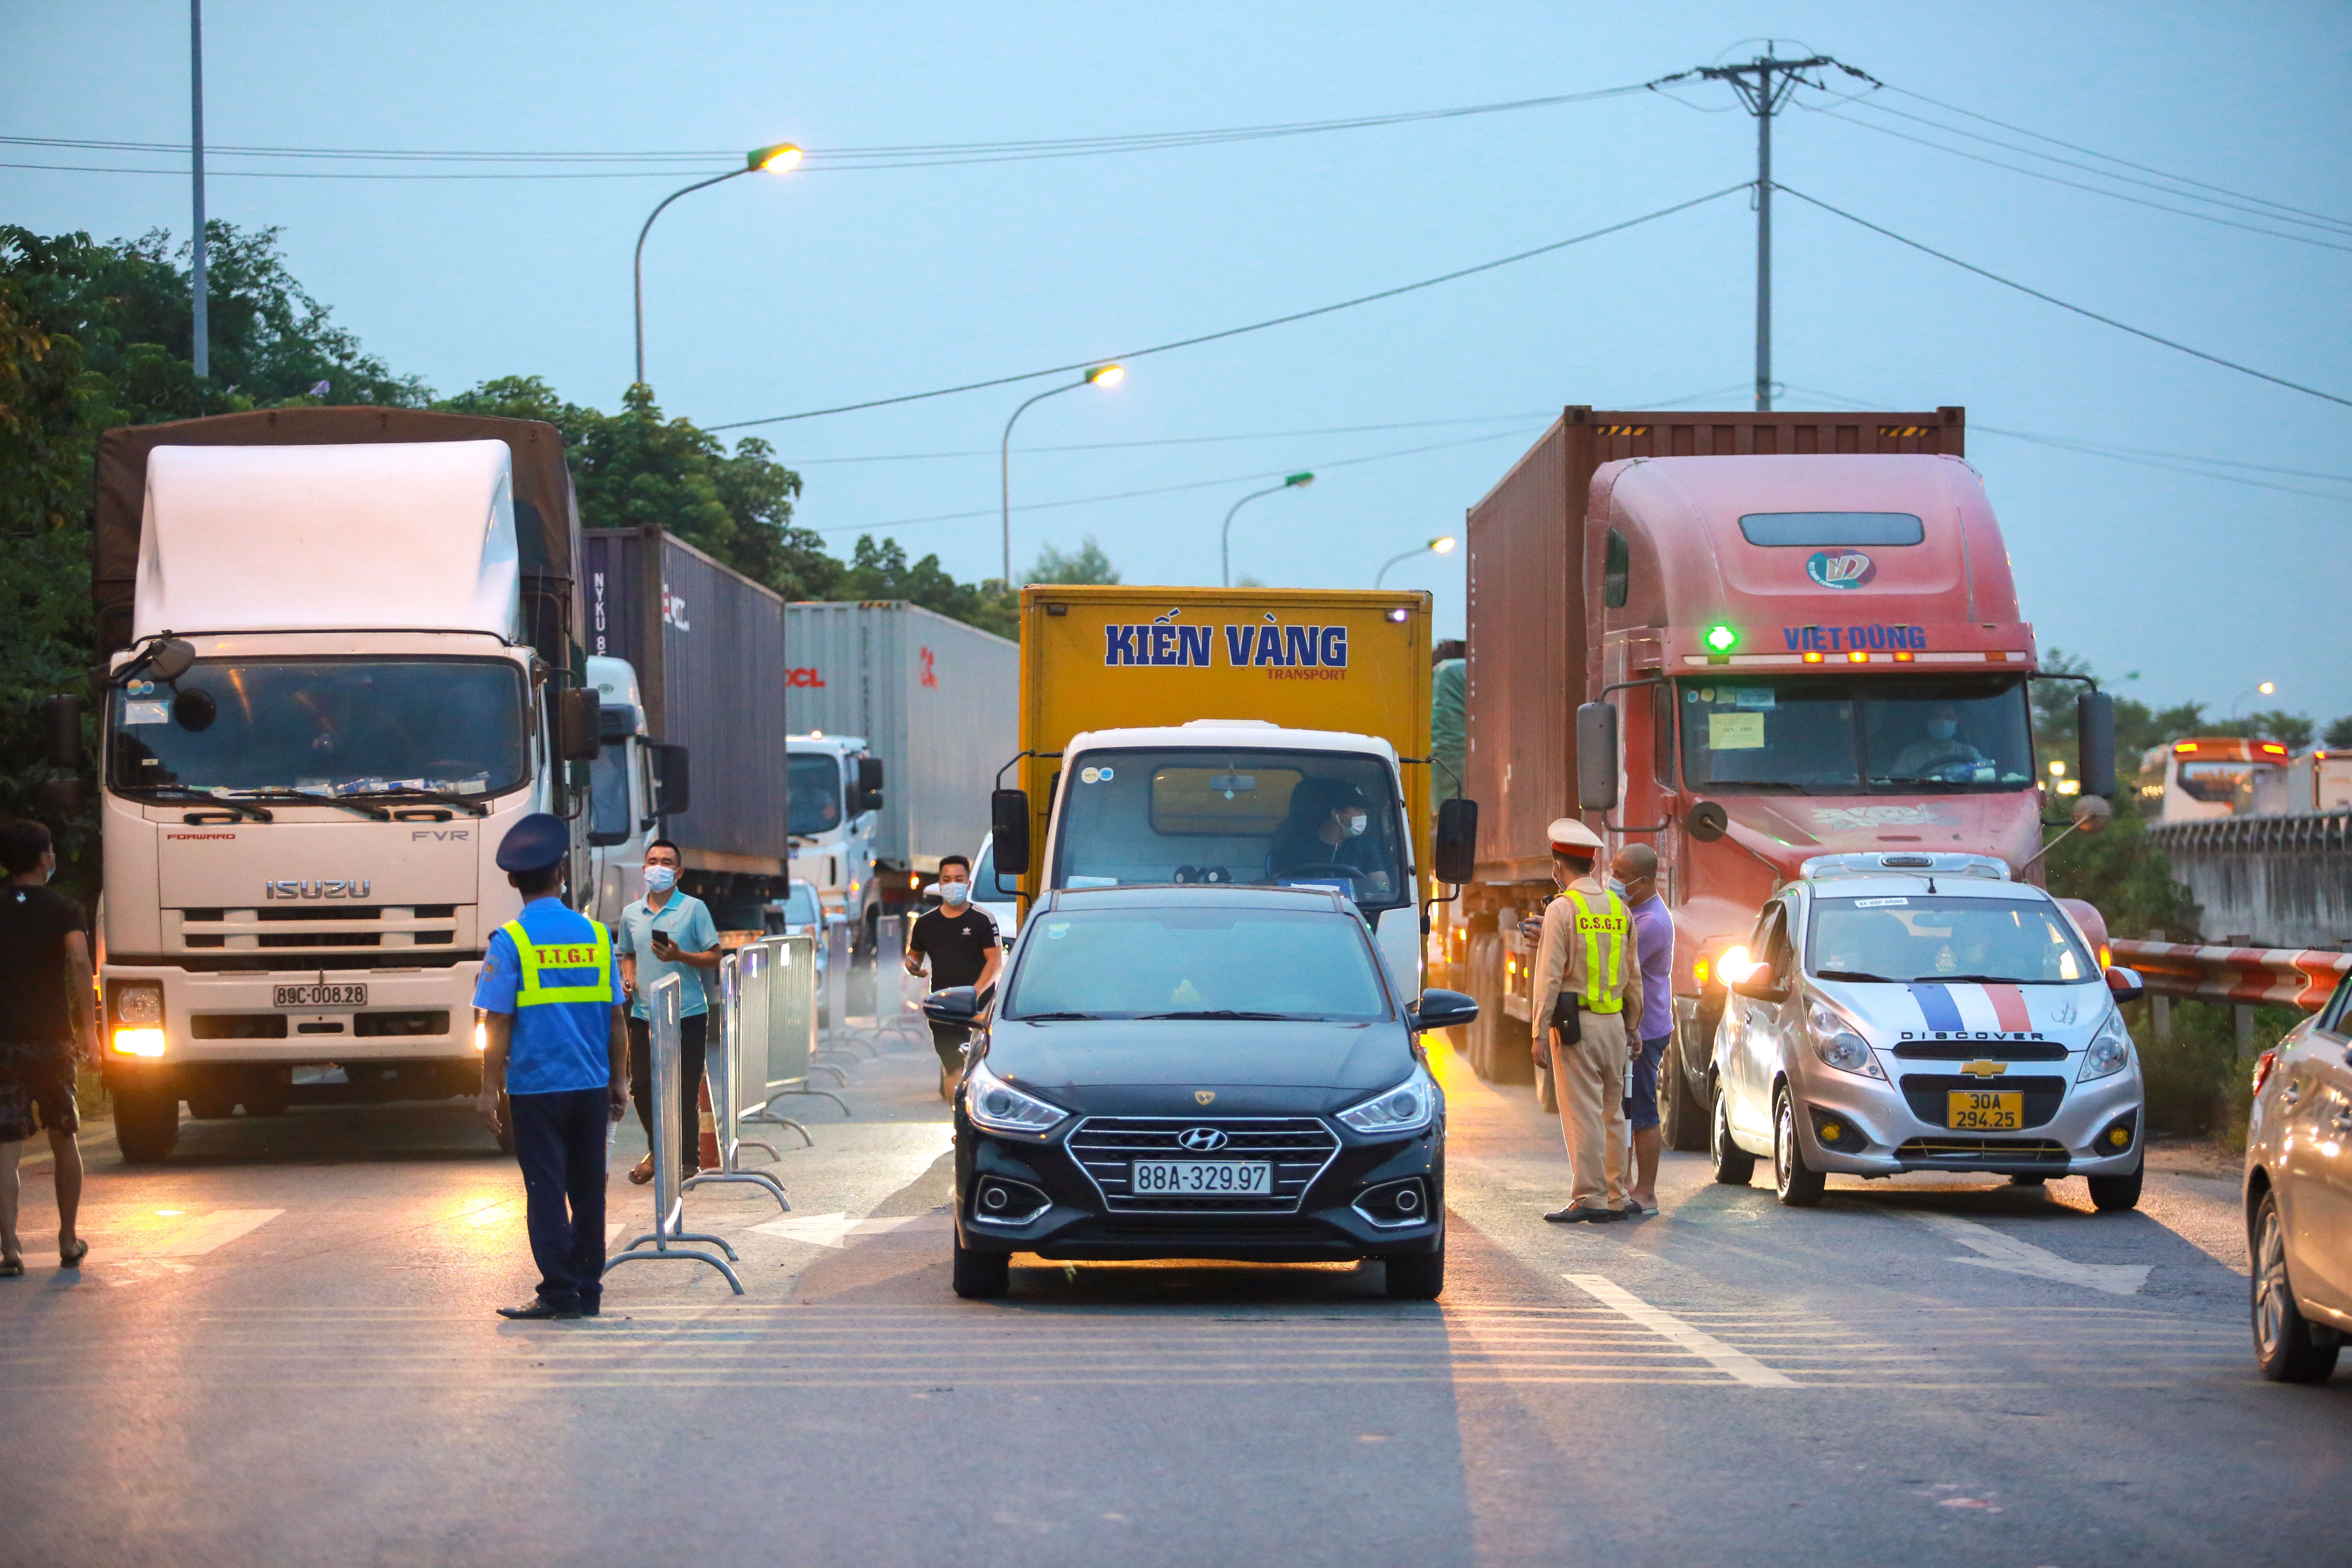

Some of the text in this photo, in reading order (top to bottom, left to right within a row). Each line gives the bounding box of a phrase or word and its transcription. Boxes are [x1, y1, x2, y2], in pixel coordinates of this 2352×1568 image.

[594, 572, 605, 631] NYKU
[1105, 607, 1348, 667] KIẾN VÀNG
[1267, 669, 1346, 680] TRANSPORT
[412, 831, 469, 841] FVR
[267, 880, 370, 899] ISUZU
[1580, 918, 1622, 930] C.S.G.T
[536, 949, 595, 964] T.T.G.T
[277, 987, 363, 1004] 89C-008.28
[1901, 1032, 2044, 1040] DISCOVER
[1970, 1094, 2001, 1109] 30A
[1957, 1111, 2014, 1127] 294.25
[1139, 1166, 1266, 1190] 88A-329.97
